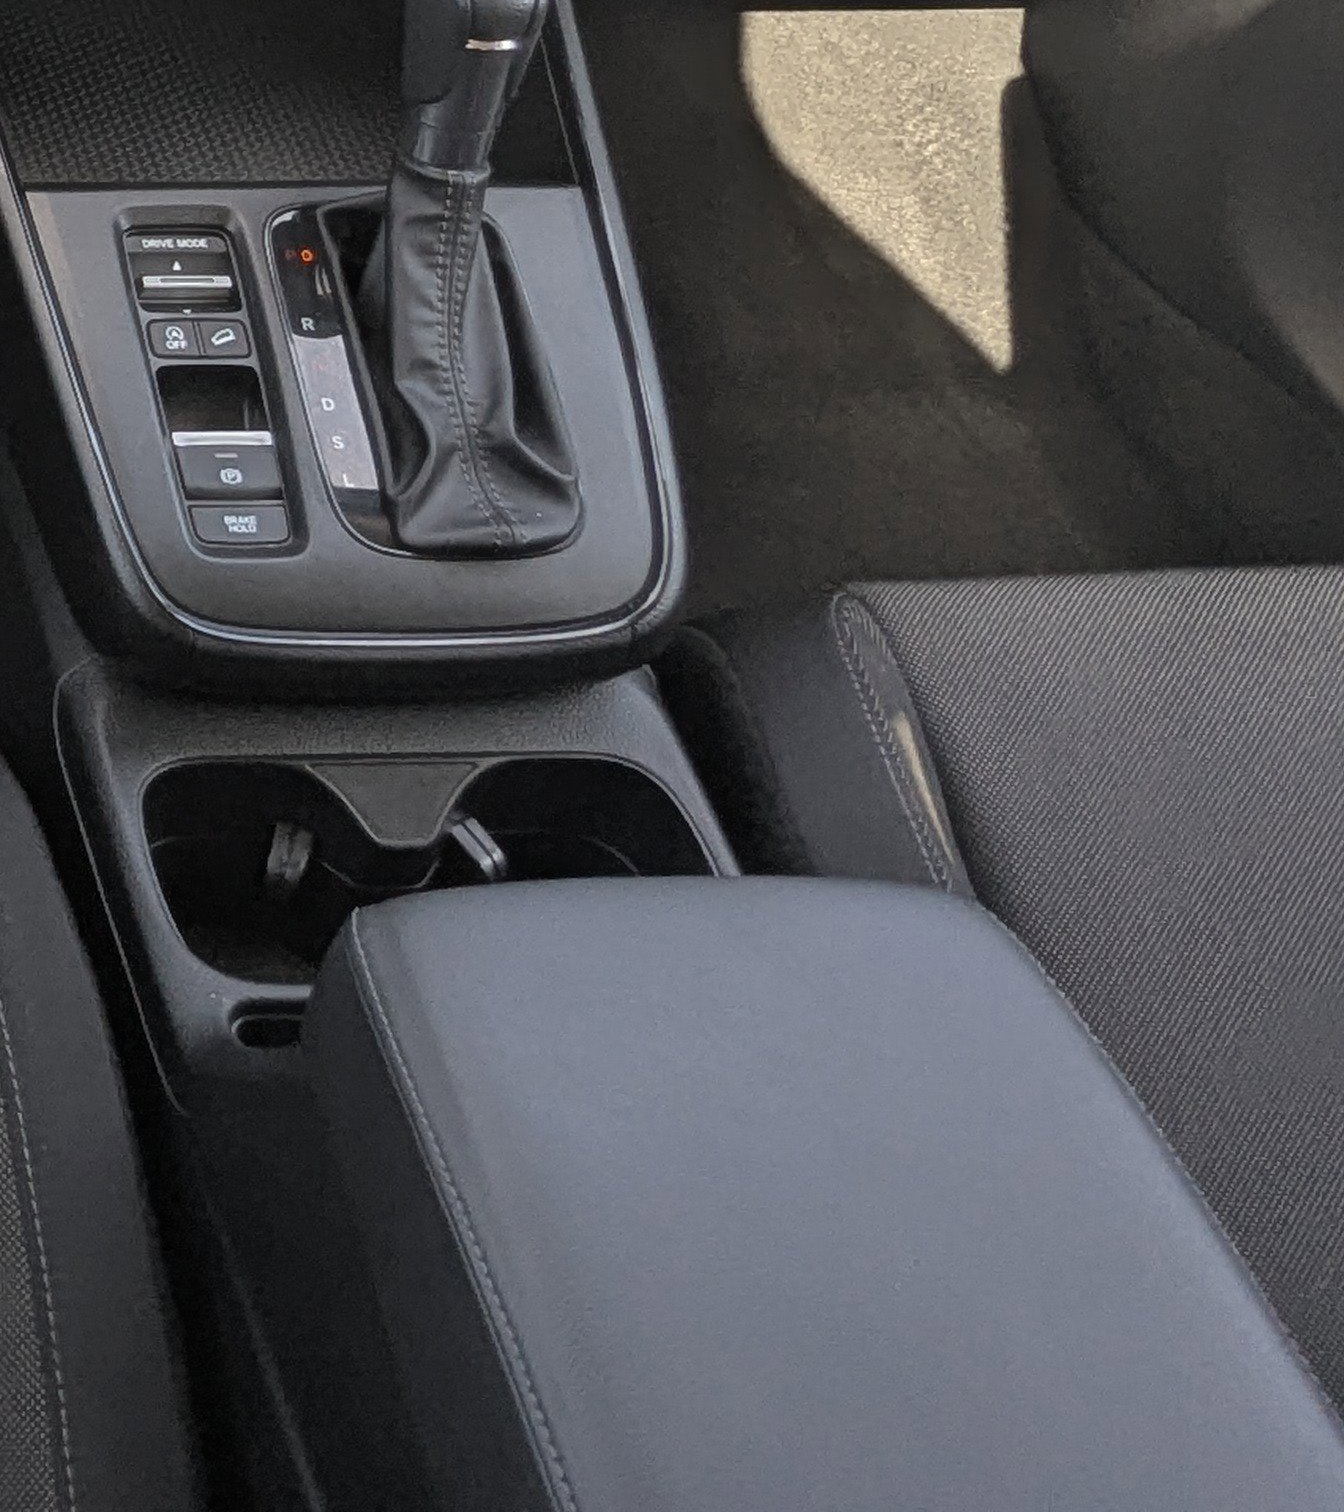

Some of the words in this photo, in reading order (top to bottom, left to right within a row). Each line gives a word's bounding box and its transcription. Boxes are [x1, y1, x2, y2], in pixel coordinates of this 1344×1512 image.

[141, 239, 175, 249] DRIVE
[176, 238, 208, 249] MODE
[301, 318, 315, 332] R
[165, 340, 187, 351] OFF
[321, 397, 336, 412] D
[331, 436, 344, 450] S
[342, 473, 355, 488] L
[224, 514, 257, 526] BRAKE
[228, 522, 257, 534] HOLD
